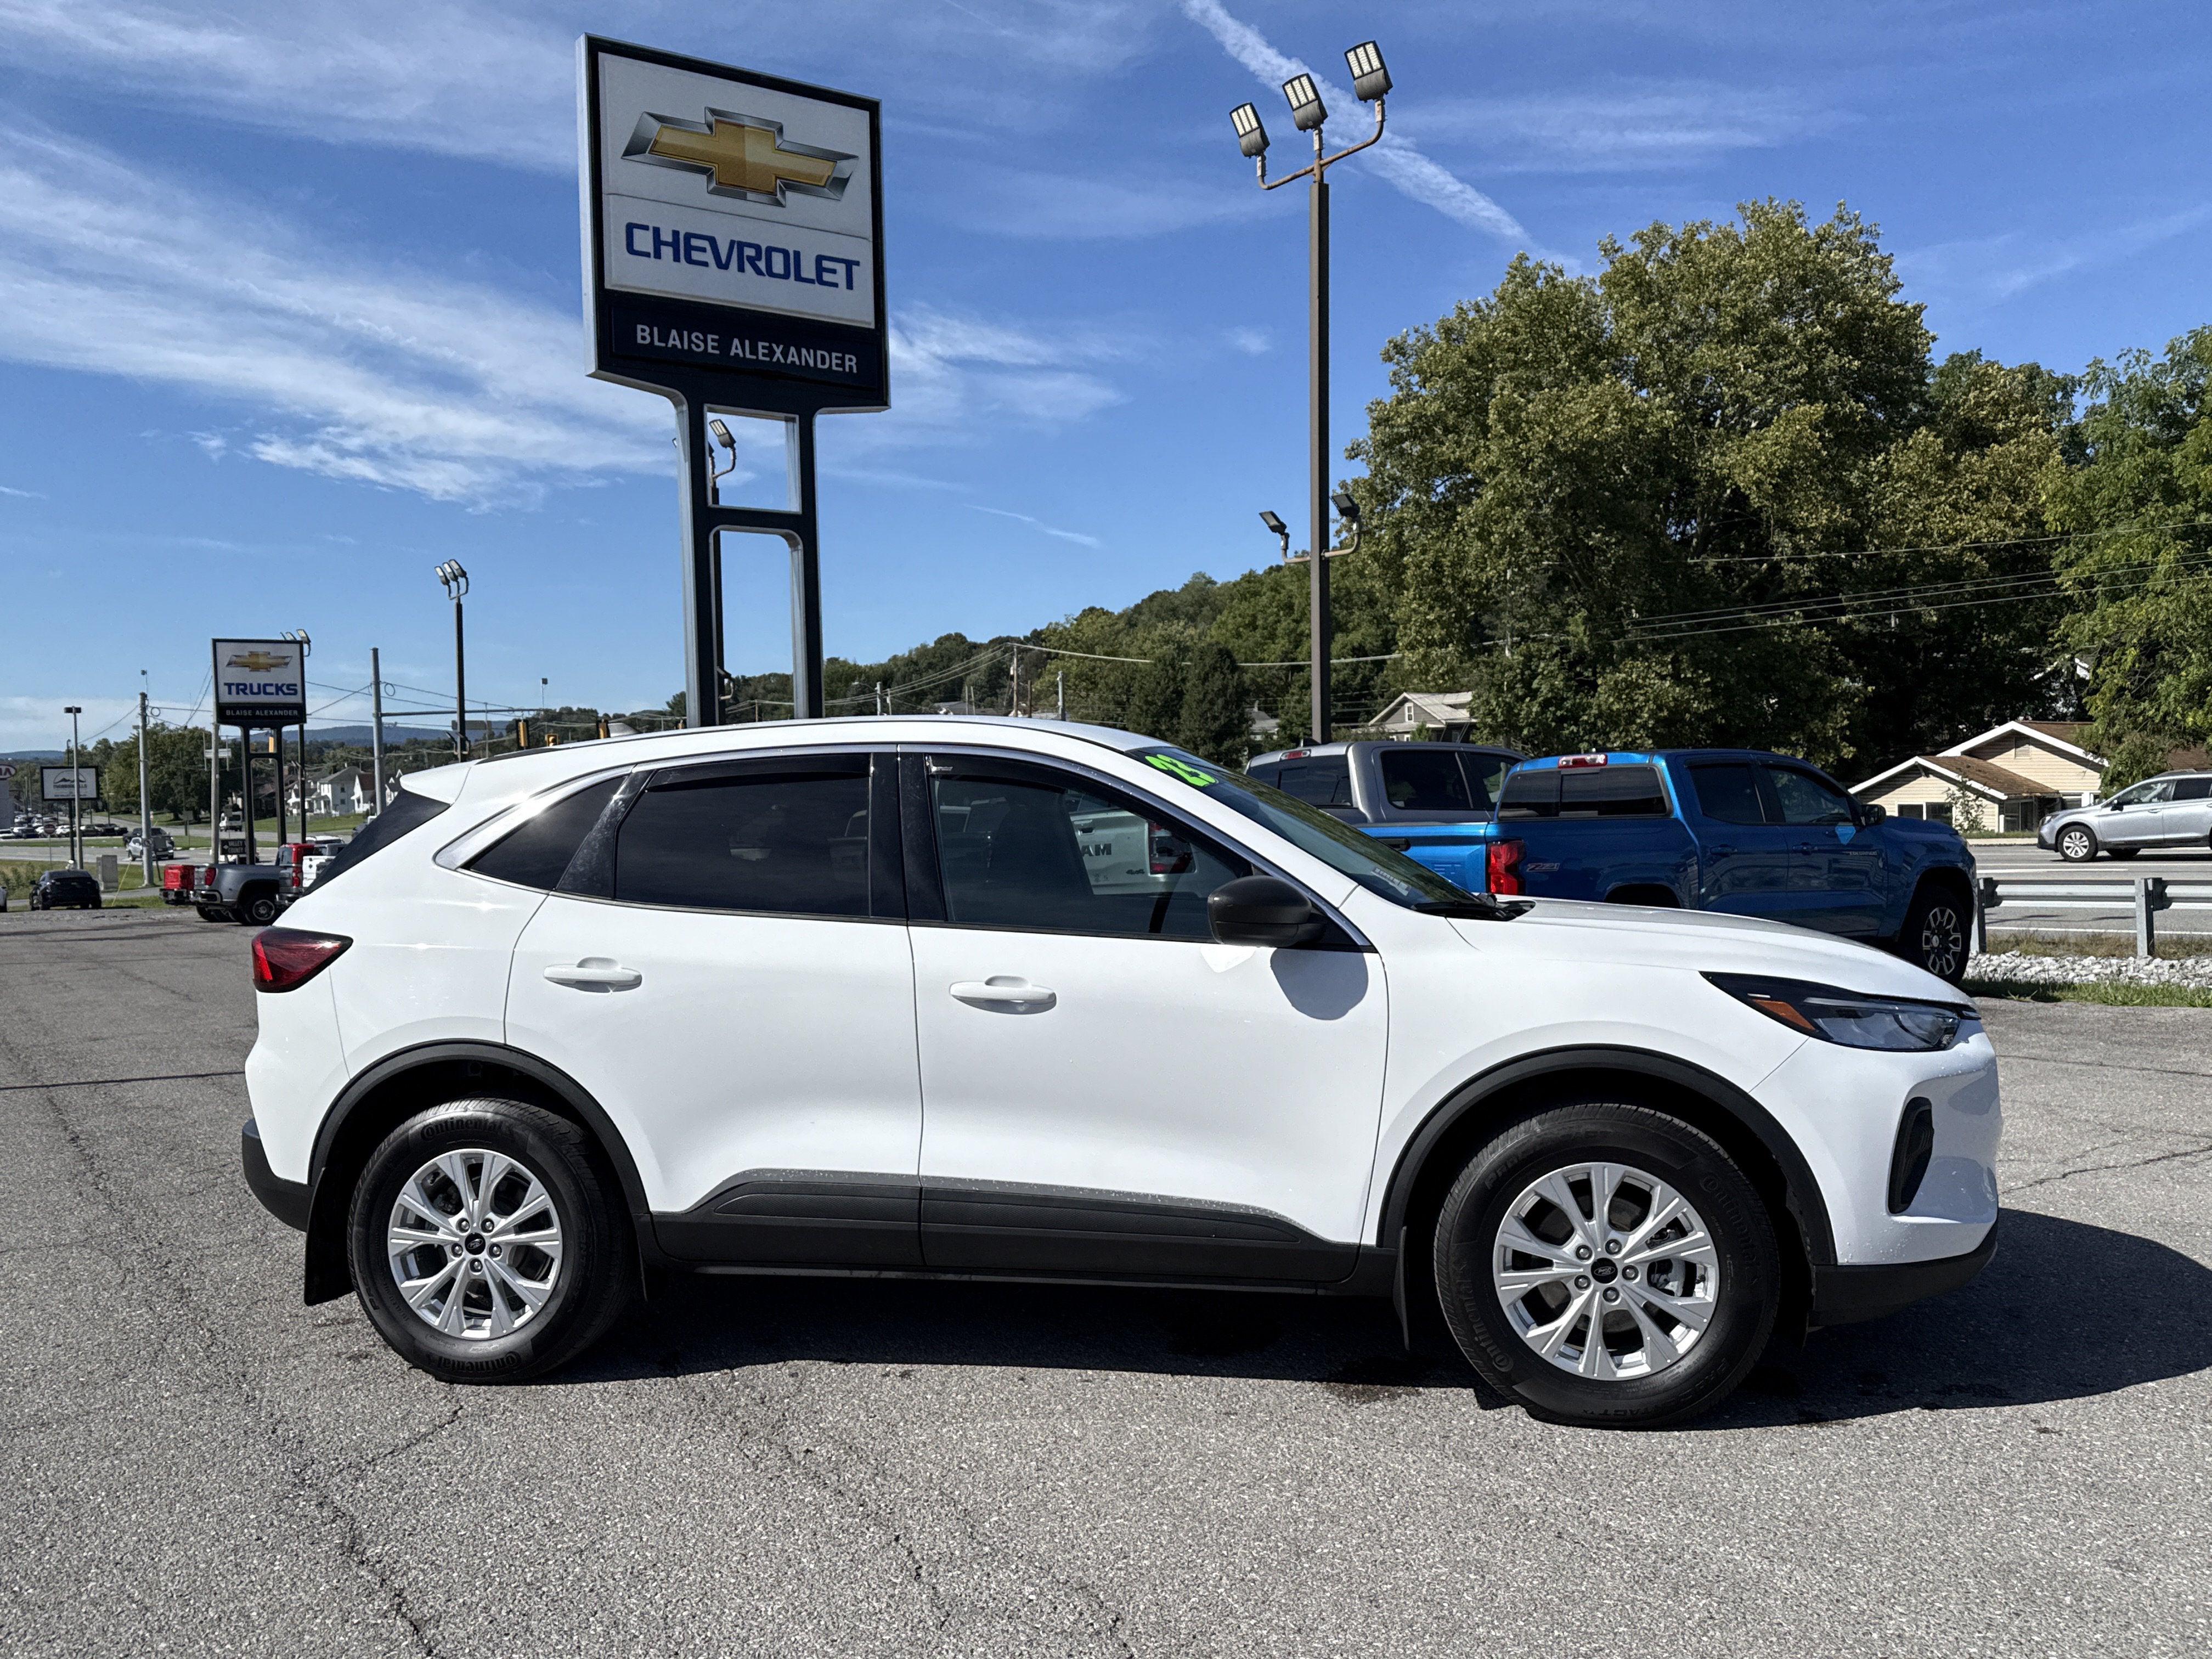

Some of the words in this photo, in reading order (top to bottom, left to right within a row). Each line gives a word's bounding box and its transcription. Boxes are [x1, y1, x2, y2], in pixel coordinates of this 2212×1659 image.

[625, 222, 860, 290] CHEVROLET
[636, 324, 720, 355] BLAISE
[729, 337, 857, 374] ALEXANDER
[224, 682, 298, 696] TRUCKS
[1081, 843, 1111, 856] AM
[420, 1118, 503, 1141] Continental
[438, 1351, 521, 1372] Continental
